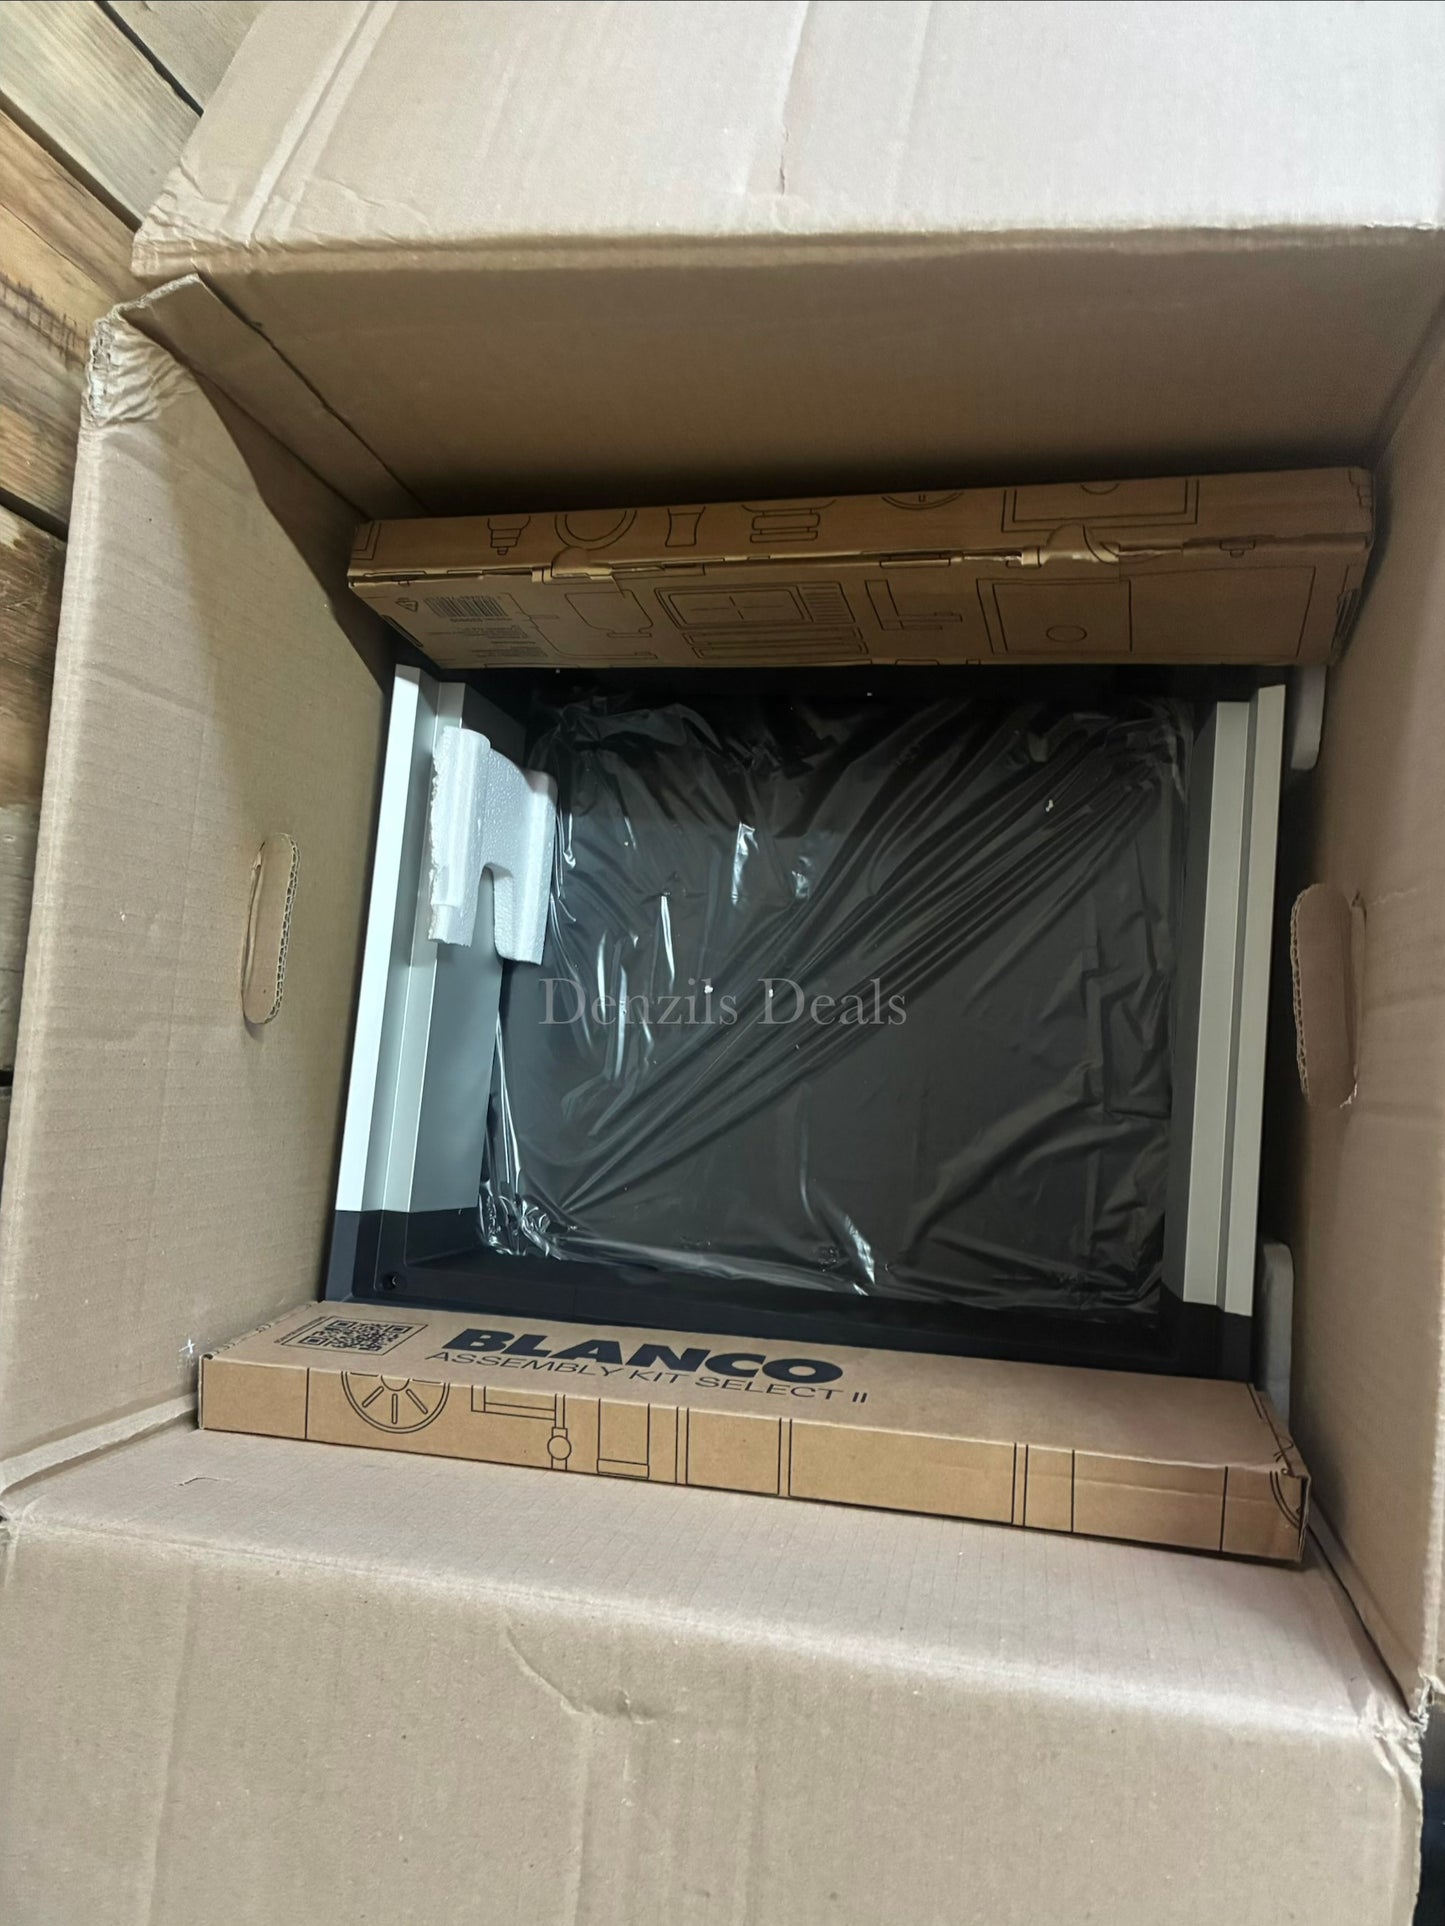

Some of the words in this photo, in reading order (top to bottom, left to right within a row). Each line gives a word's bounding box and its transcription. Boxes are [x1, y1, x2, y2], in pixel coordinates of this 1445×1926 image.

[425, 1351, 624, 1377] ASSEMBLY
[628, 1369, 689, 1384] KIT
[695, 1376, 844, 1400] SELECT
[852, 1391, 868, 1403] II
[441, 1328, 843, 1384] BLANCO
